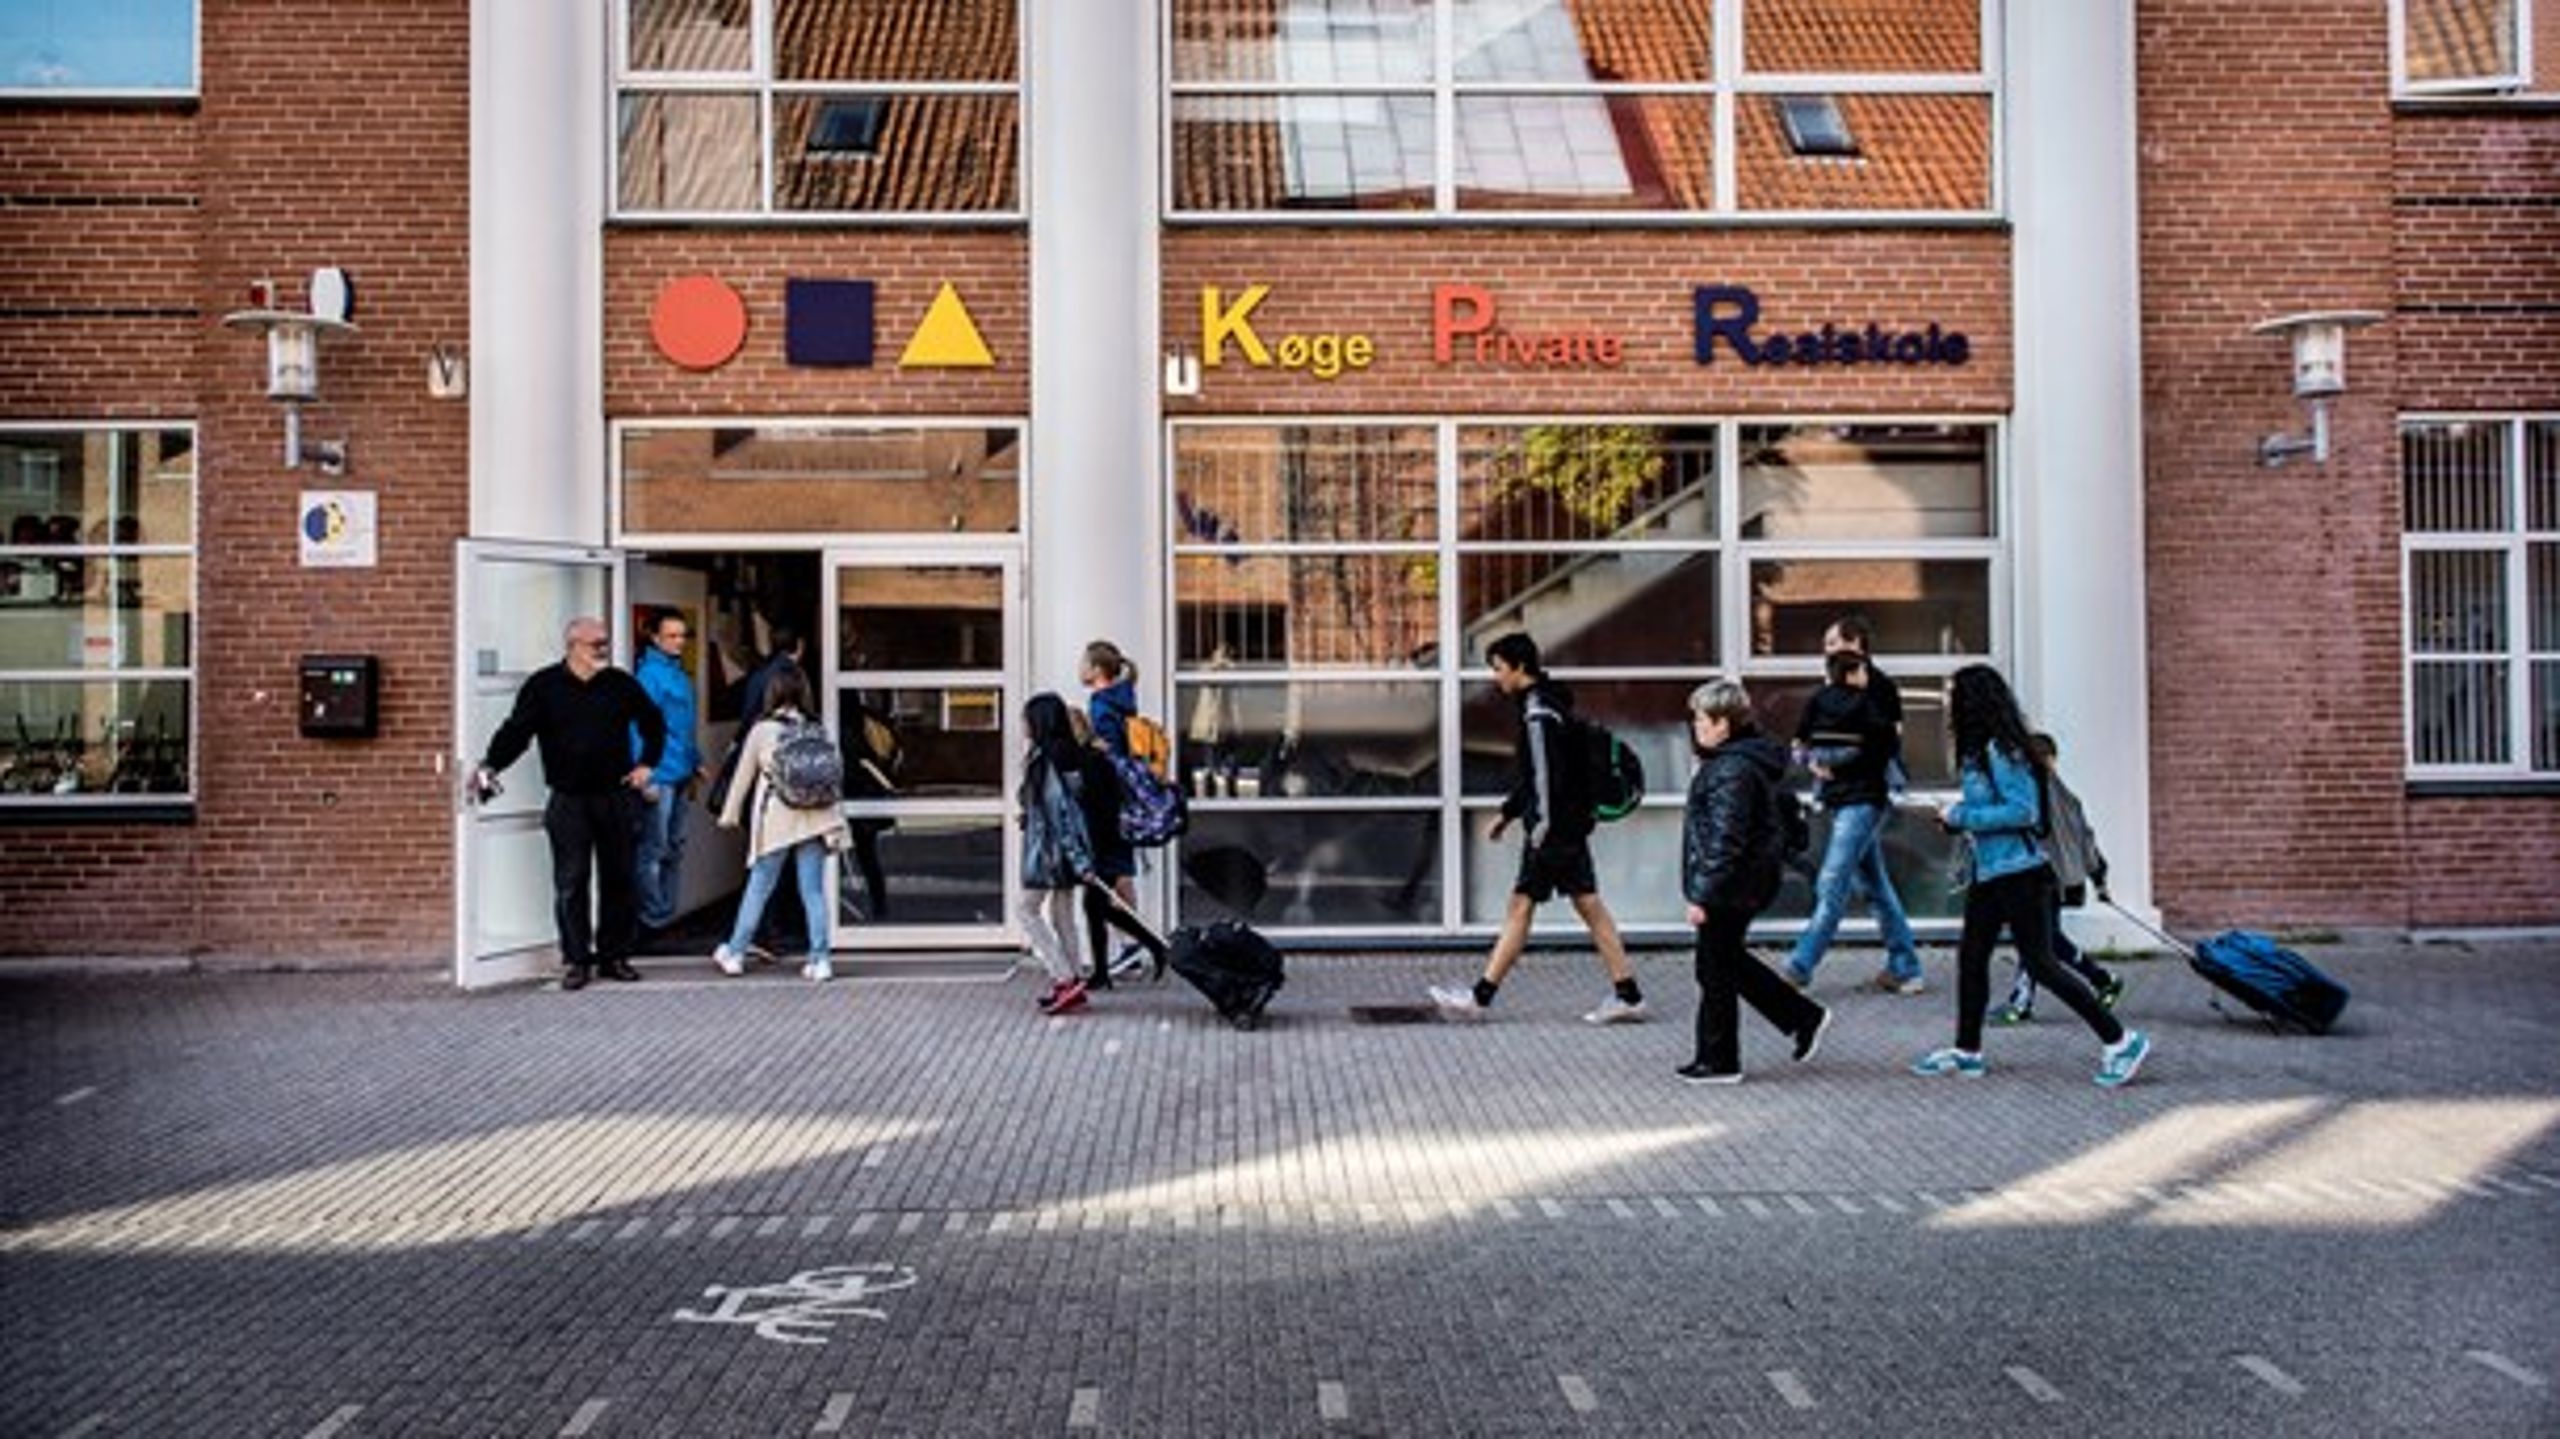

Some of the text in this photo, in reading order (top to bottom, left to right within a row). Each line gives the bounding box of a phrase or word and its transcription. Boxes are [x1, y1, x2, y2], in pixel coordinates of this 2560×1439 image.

[1203, 284, 1970, 377] Køge Private Realskole
